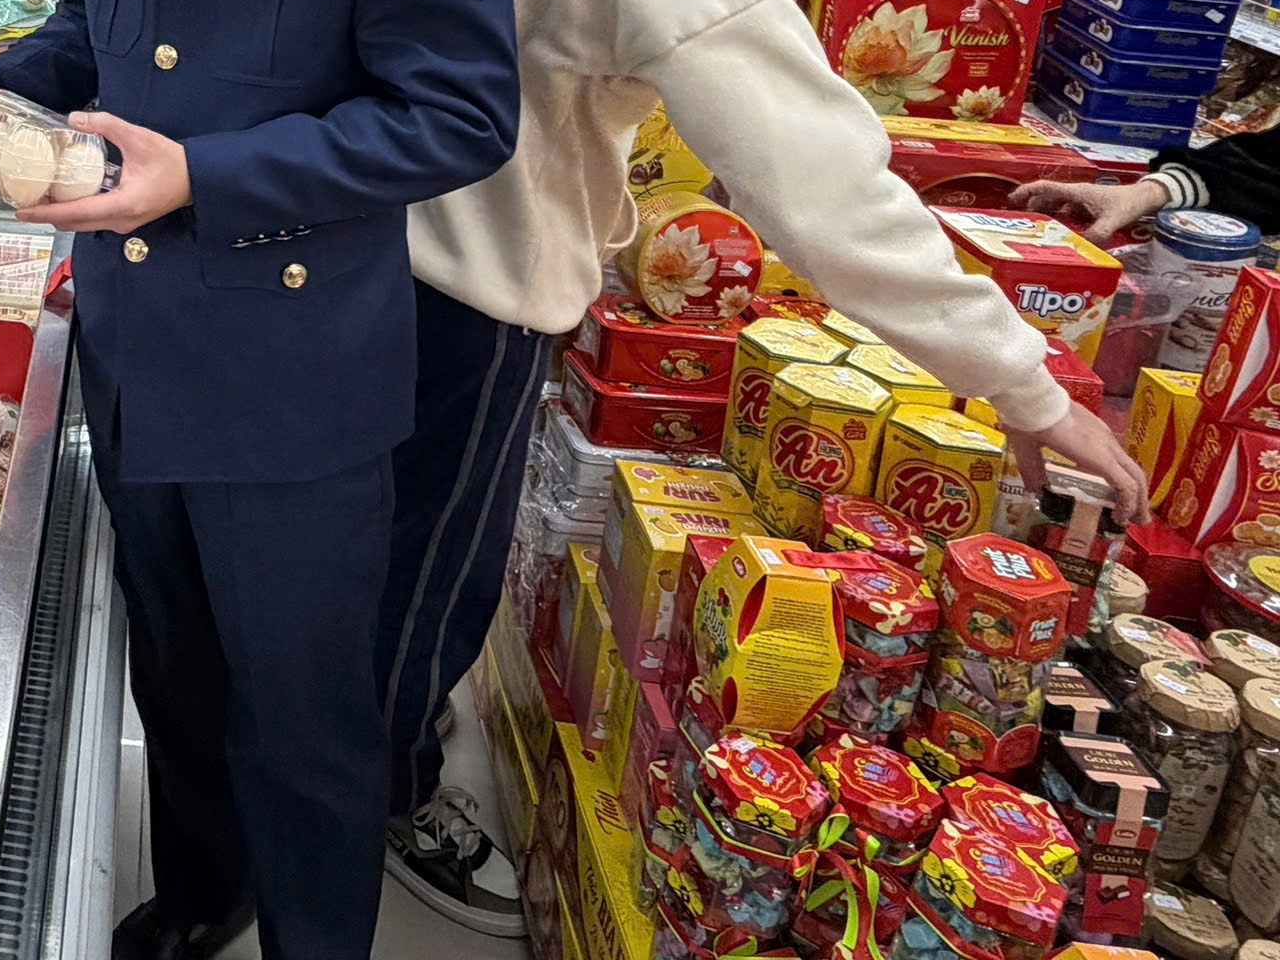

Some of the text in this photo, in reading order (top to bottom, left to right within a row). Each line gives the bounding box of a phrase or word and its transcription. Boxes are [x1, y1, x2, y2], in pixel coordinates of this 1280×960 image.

[942, 25, 1010, 47] Vanish
[1017, 285, 1088, 317] Tipo
[670, 513, 731, 529] SURI
[1046, 680, 1087, 692] OLDEN
[1092, 852, 1143, 867] GOLDEN
